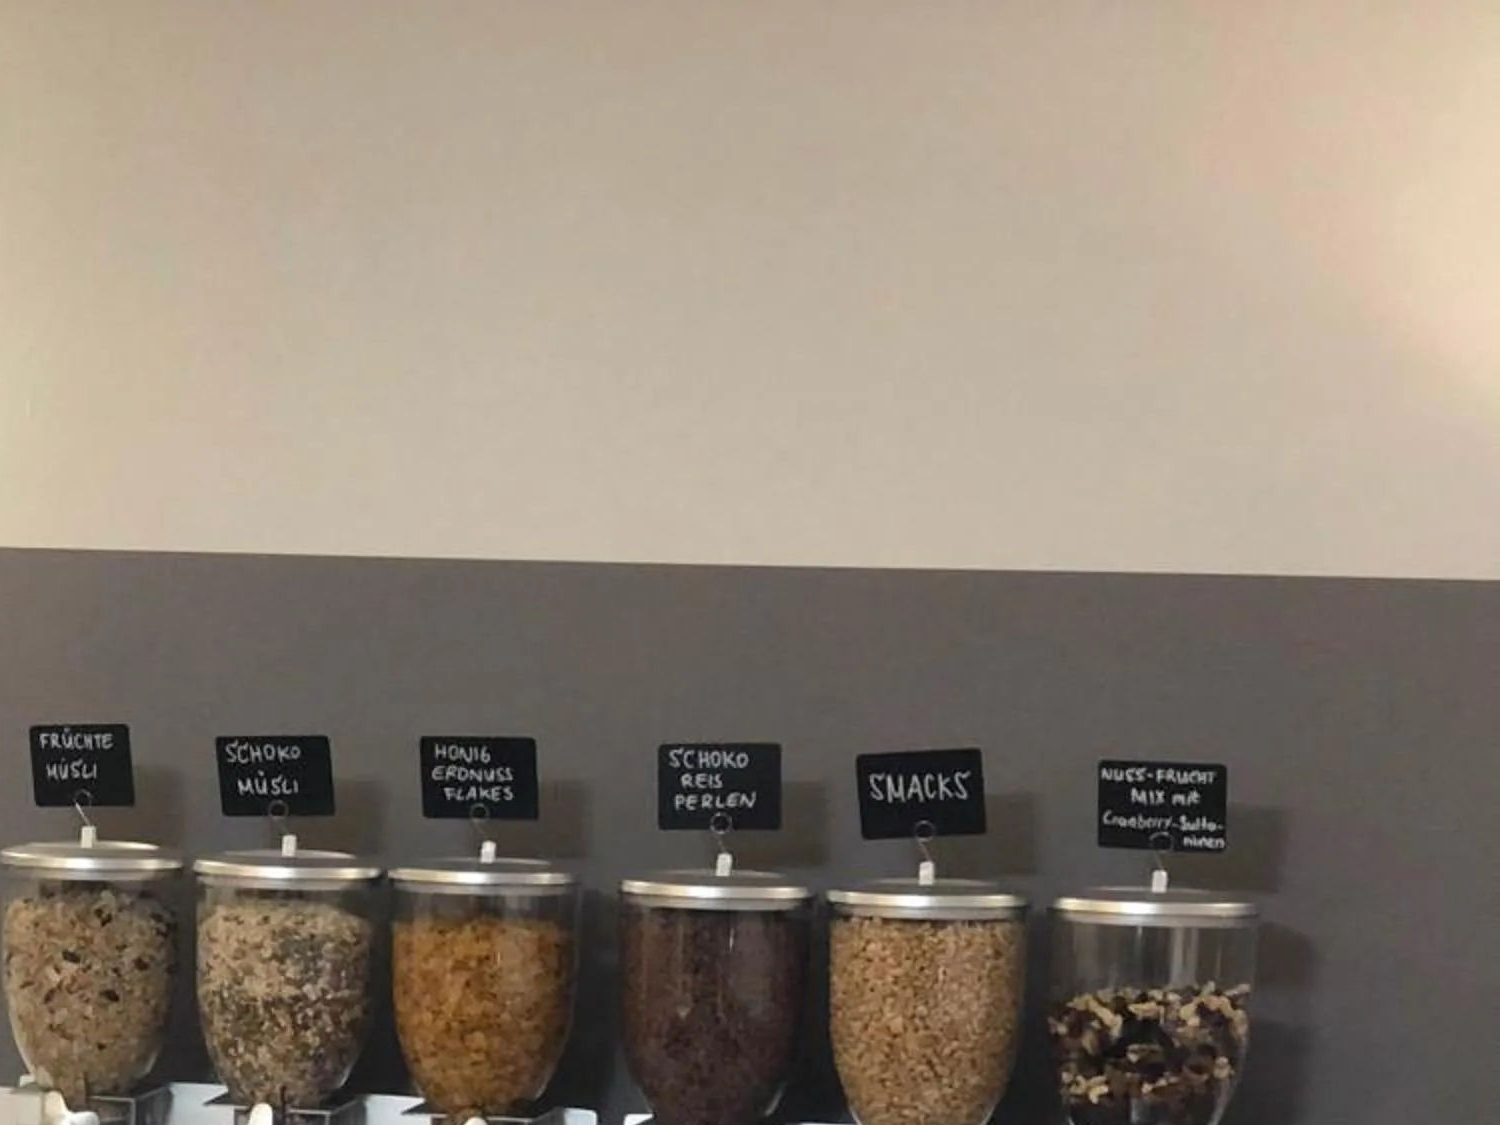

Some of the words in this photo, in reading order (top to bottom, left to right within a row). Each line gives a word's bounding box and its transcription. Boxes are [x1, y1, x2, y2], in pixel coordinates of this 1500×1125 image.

[40, 727, 114, 750] FRÜCHTE
[225, 740, 301, 763] SCHOKO
[435, 744, 491, 763] HONIG
[668, 748, 749, 769] SCHOKO
[46, 757, 97, 780] MÜSLI
[431, 765, 514, 782] ERDNUSS
[238, 770, 299, 795] MÜSLI
[681, 773, 723, 789] REIS
[869, 770, 972, 803] SMACKS
[443, 786, 514, 802] FLAKES
[675, 791, 757, 811] PERLEN
[1130, 787, 1165, 806] MIX
